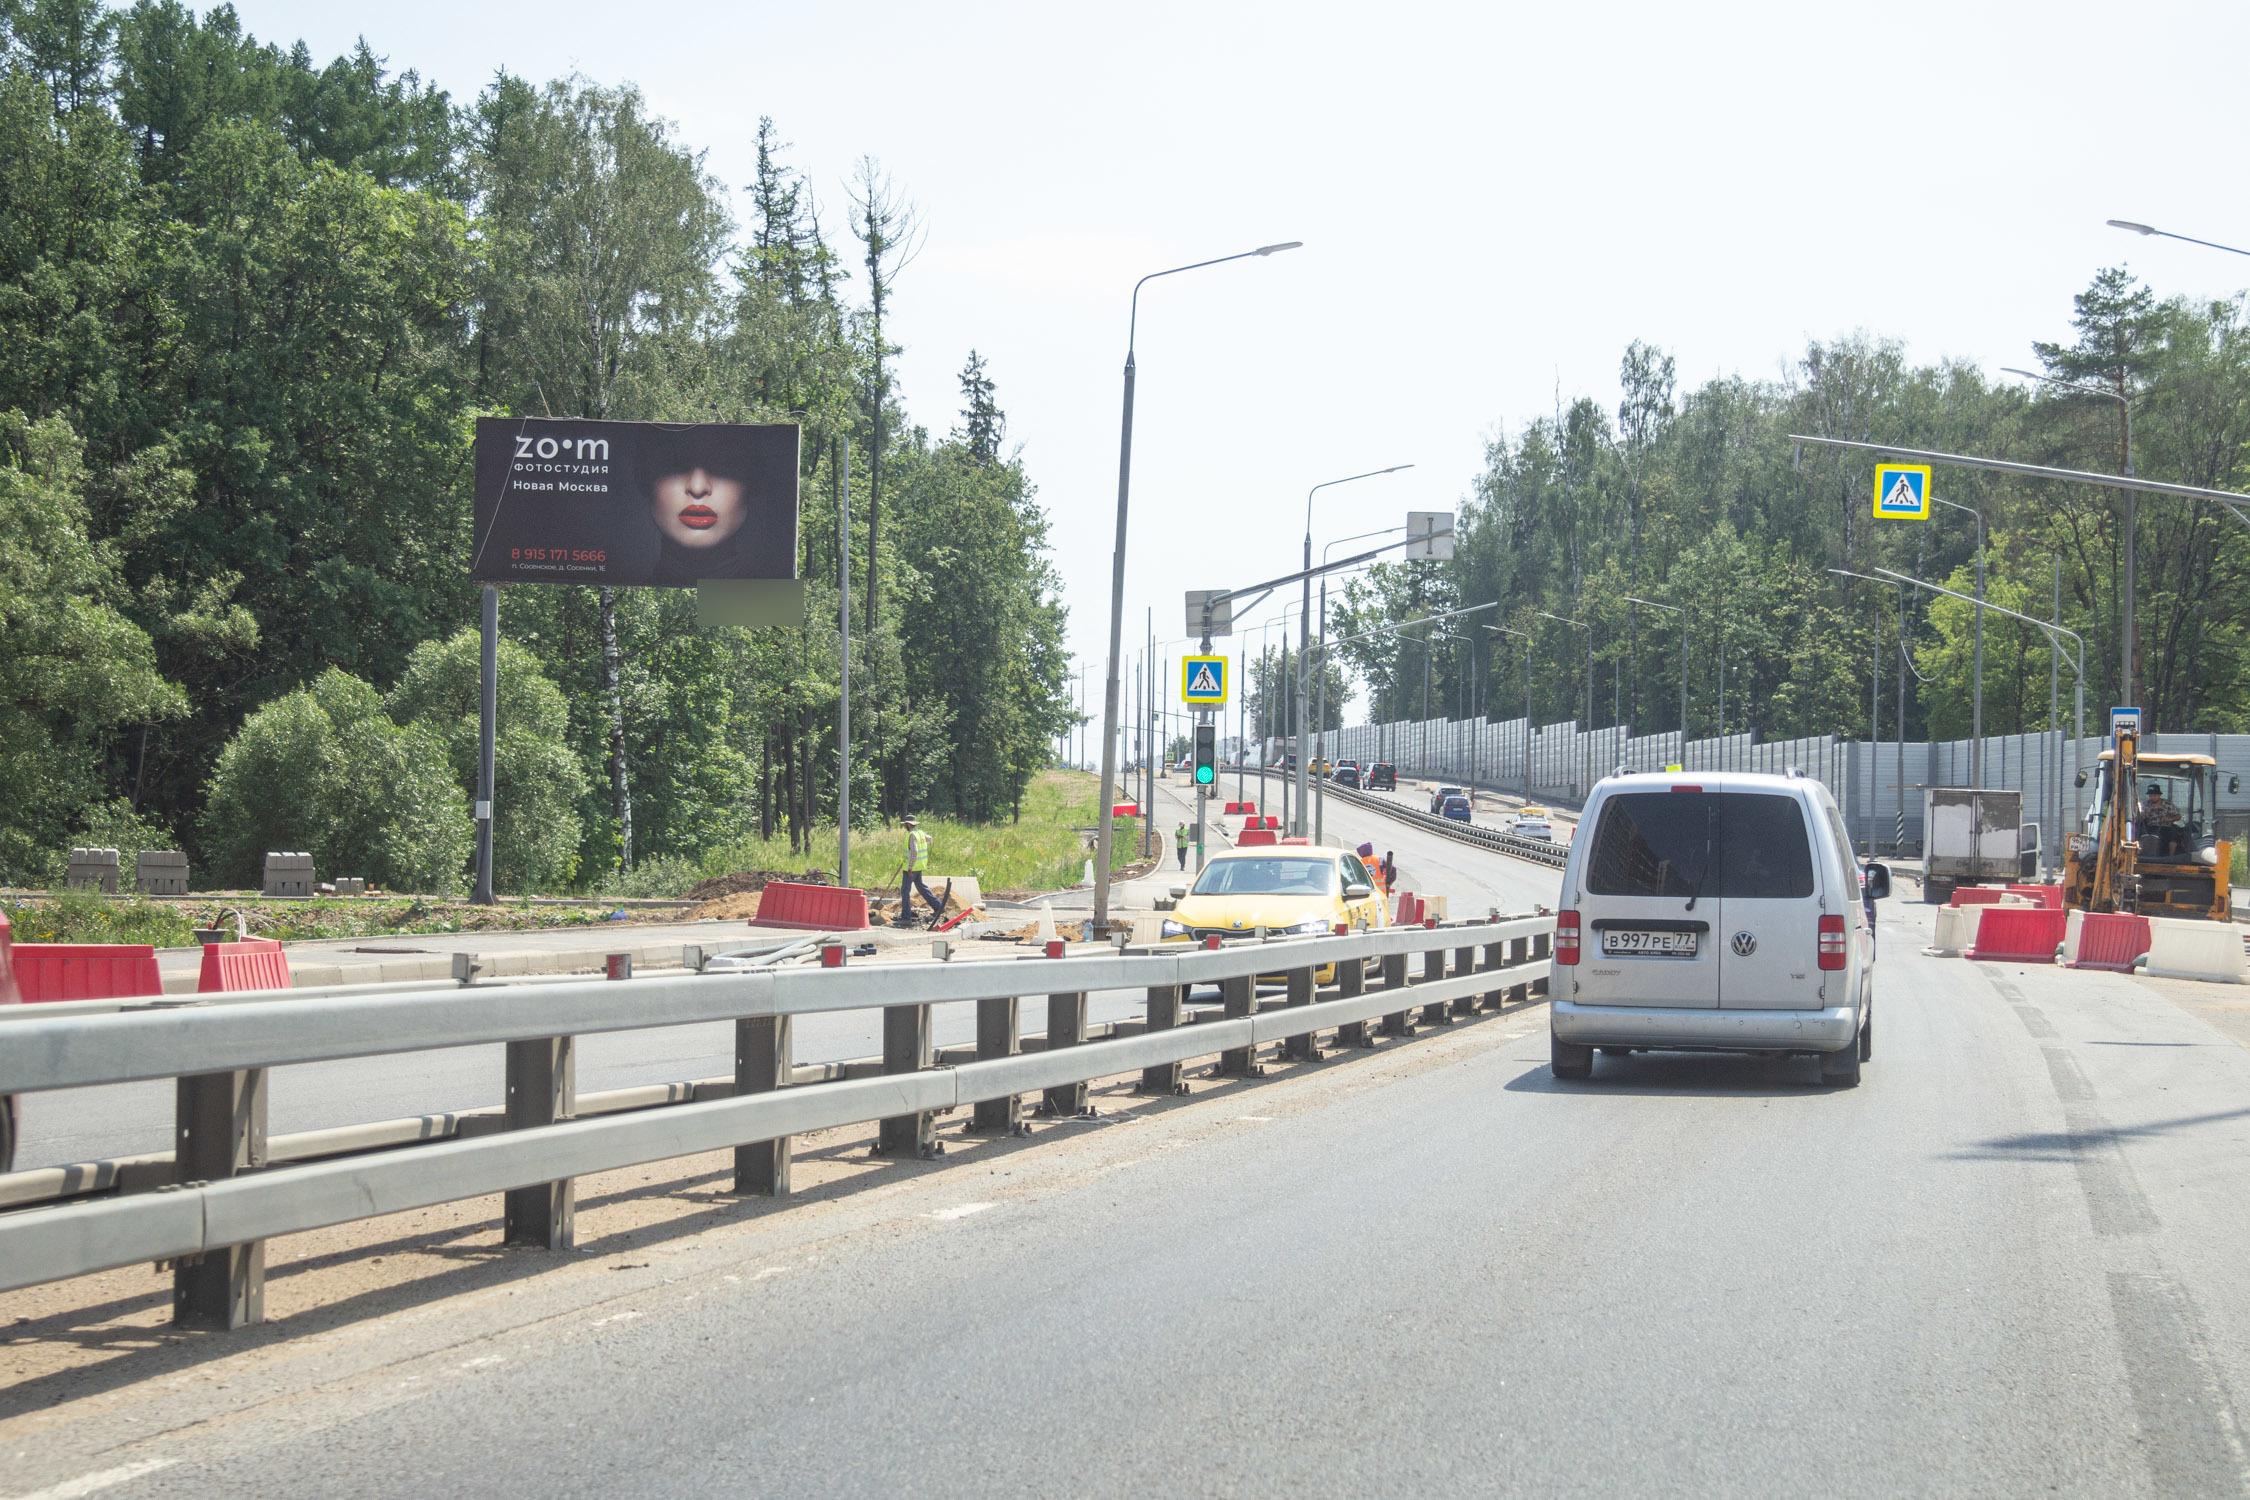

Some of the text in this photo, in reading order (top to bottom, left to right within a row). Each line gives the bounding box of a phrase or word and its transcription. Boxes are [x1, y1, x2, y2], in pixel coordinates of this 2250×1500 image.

[514, 463, 609, 475] ФОТОСТУДИЯ
[513, 480, 608, 493] Новая Москва
[511, 548, 606, 562] 8 915 171 5666
[519, 562, 558, 571] Сосенское,
[566, 564, 598, 572] Сосенки,
[1676, 933, 1691, 945] 77
